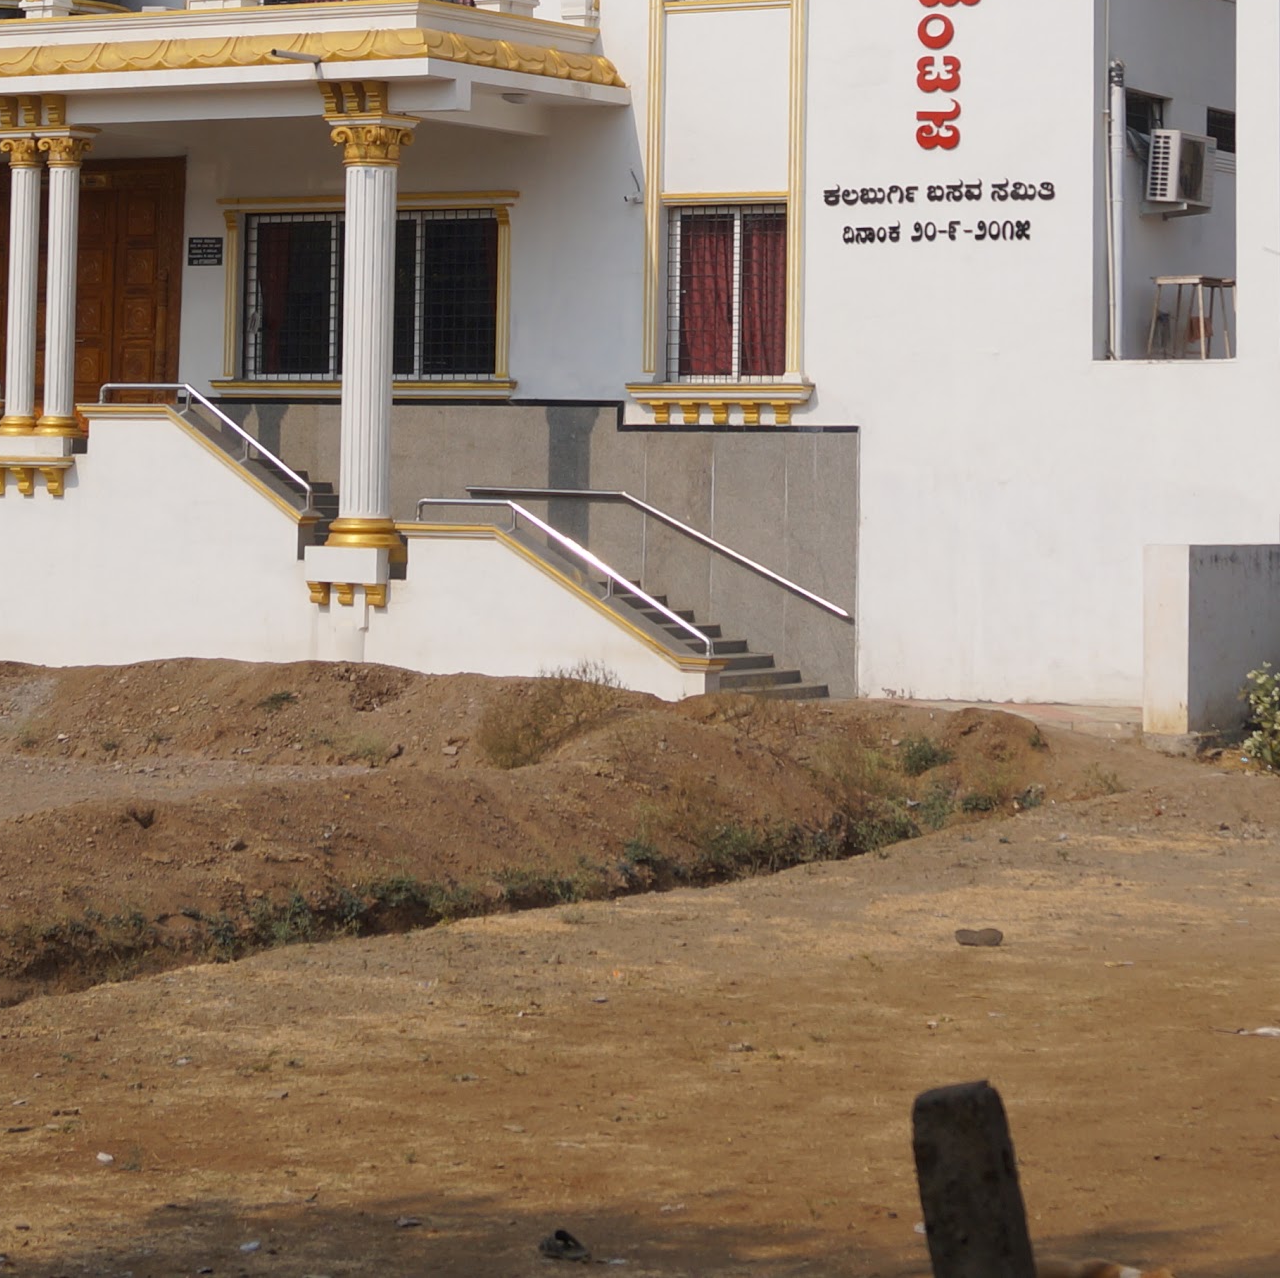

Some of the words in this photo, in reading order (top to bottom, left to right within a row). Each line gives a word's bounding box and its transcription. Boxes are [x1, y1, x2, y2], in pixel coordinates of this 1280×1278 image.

[823, 184, 918, 207] ಕಲಬುರ್ಗಿ
[926, 179, 983, 203] ಬಸವ
[991, 178, 1056, 202] ಸಮಿತಿ
[842, 220, 901, 245] ದಿನಾಂಕ
